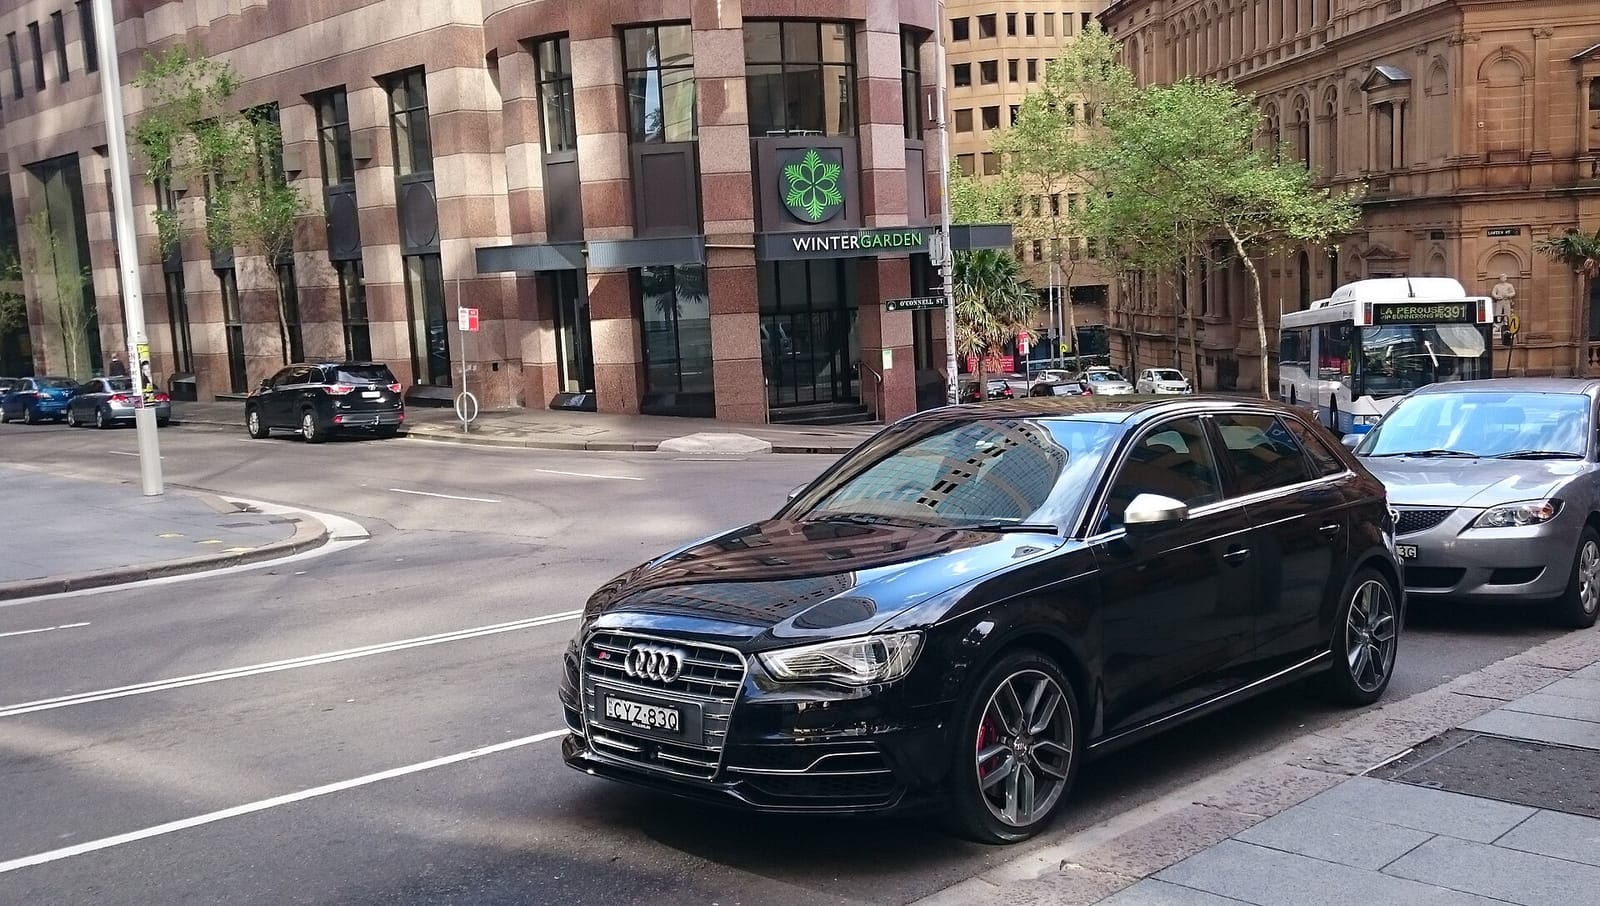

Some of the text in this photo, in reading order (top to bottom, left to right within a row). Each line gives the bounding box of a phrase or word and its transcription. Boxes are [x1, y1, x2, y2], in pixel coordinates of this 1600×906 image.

[792, 232, 922, 252] WINTERGARDEN
[899, 298, 934, 307] O'CONNELL
[1380, 305, 1444, 316] LA PEROUSE
[1444, 305, 1465, 318] 391
